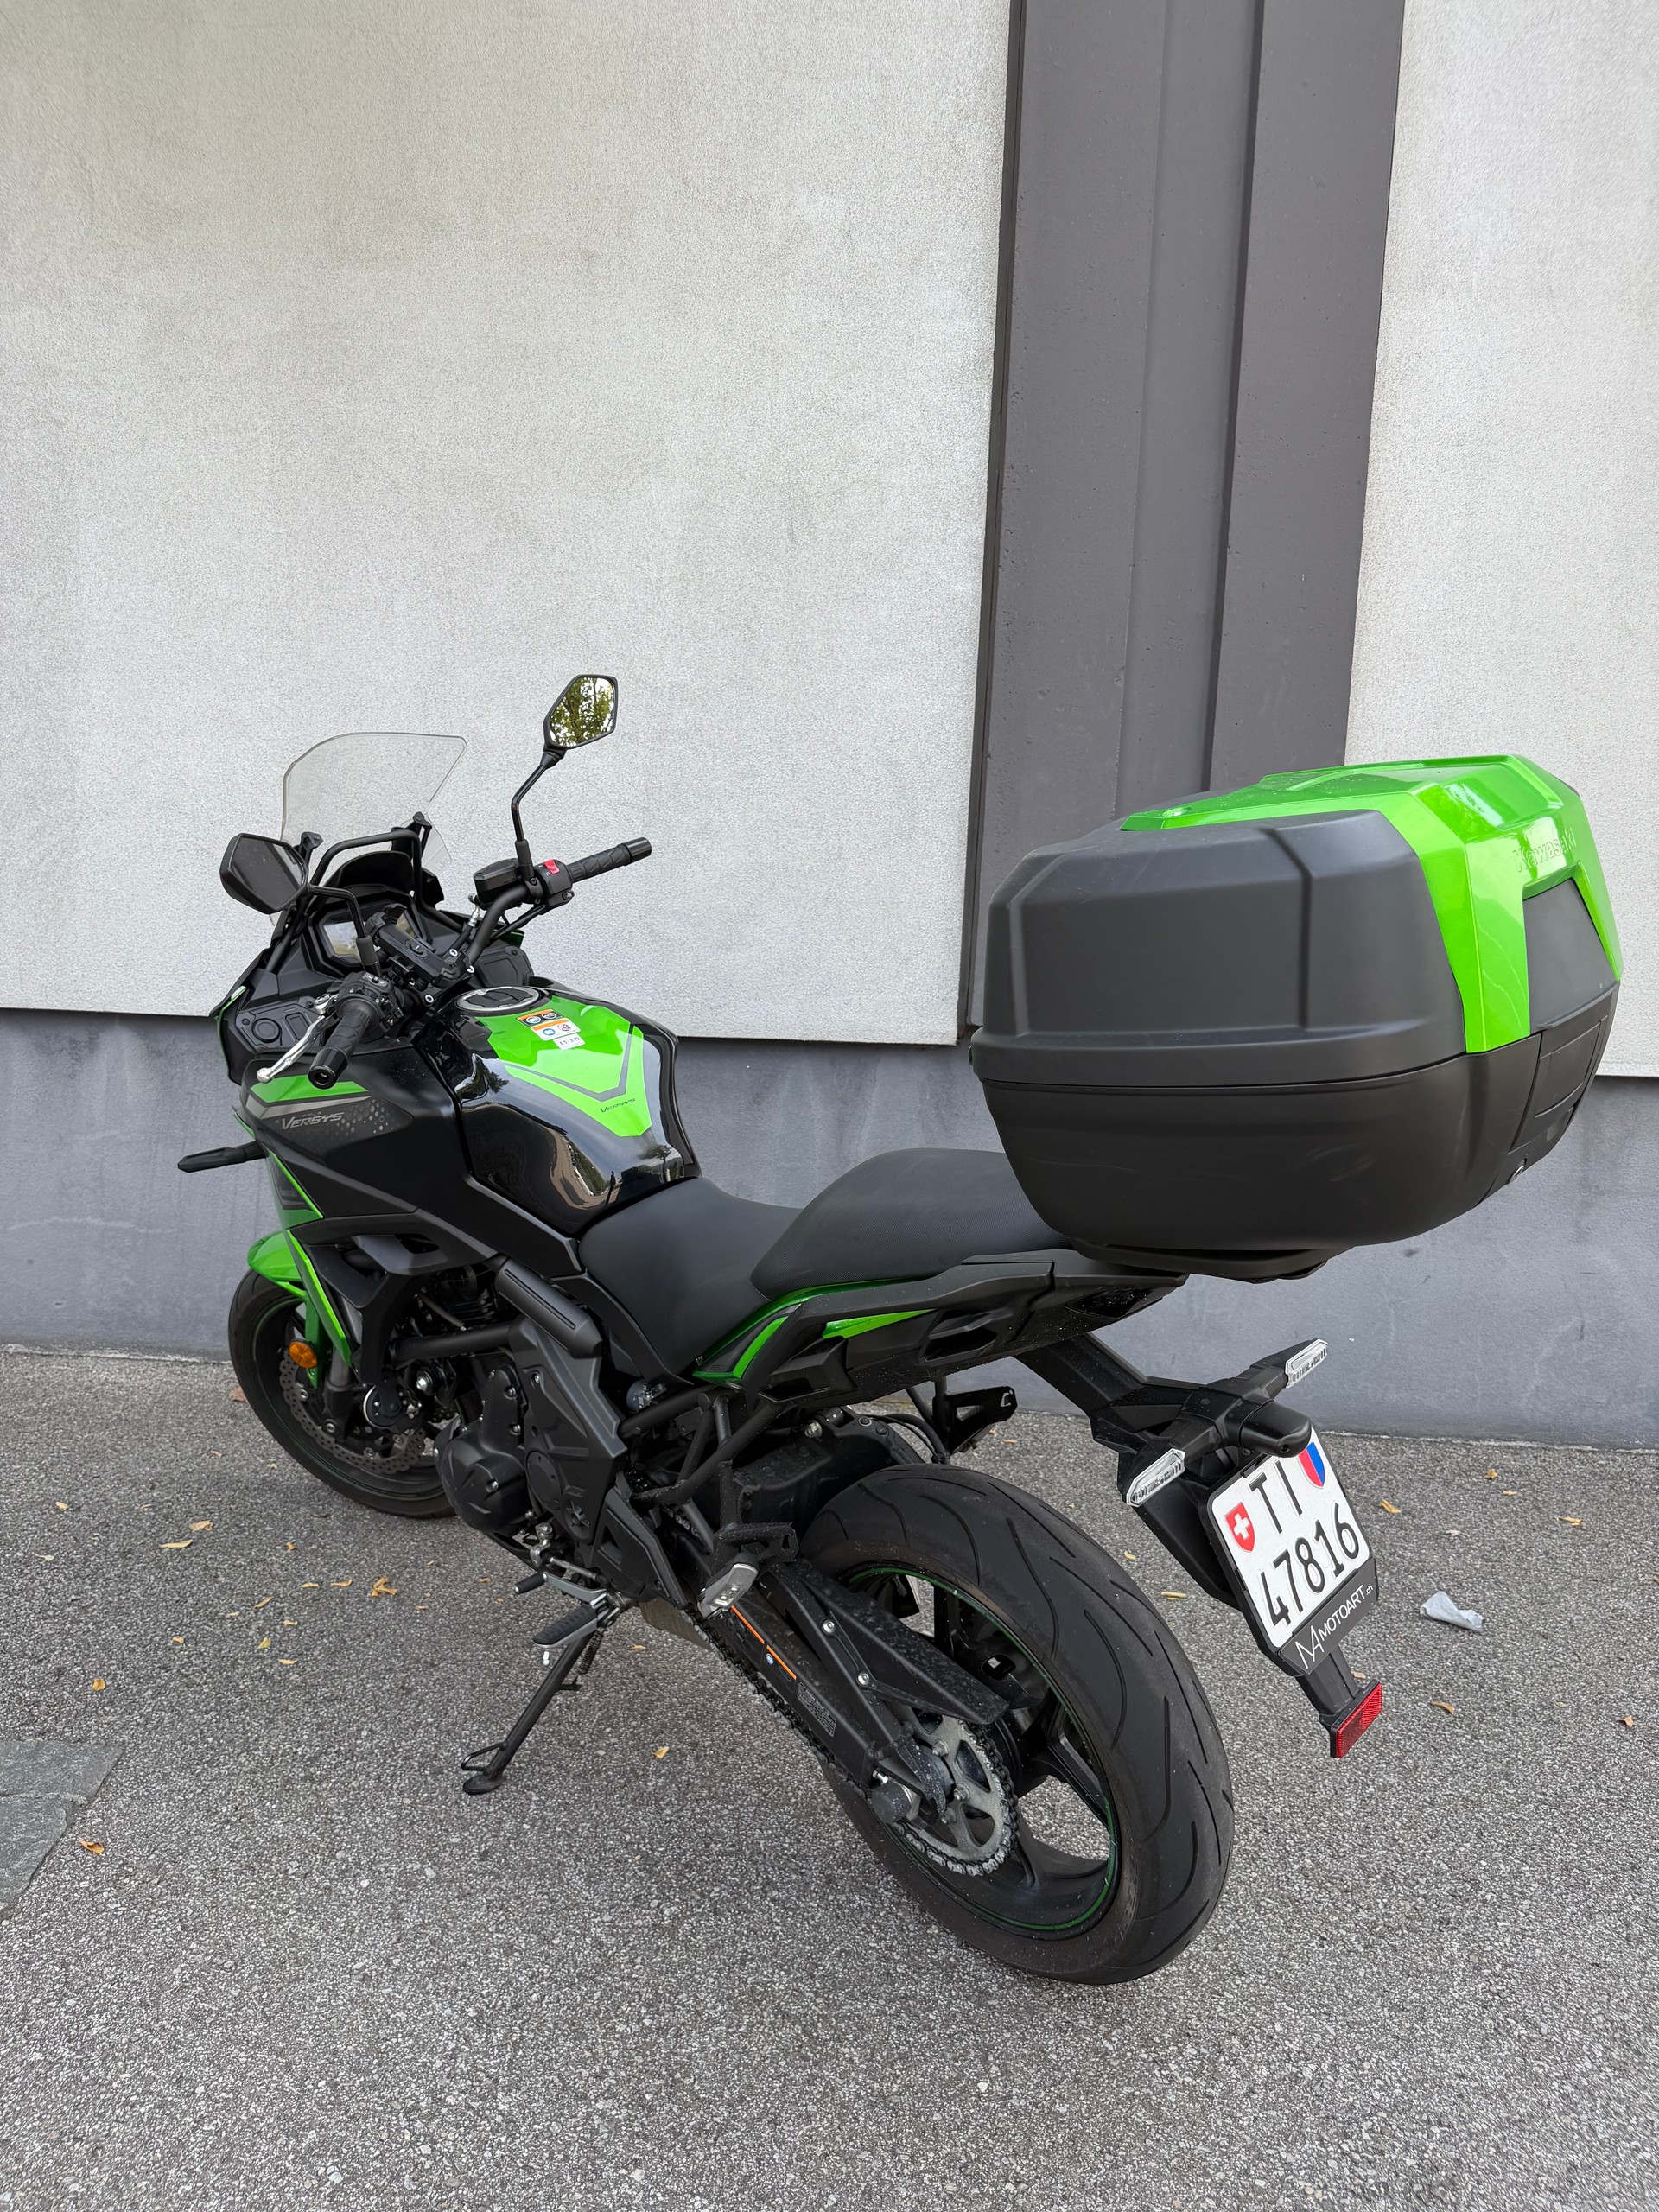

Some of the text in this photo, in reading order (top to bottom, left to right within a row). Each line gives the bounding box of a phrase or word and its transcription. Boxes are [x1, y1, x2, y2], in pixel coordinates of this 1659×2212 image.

[1512, 827, 1577, 873] Kawasaki
[282, 1112, 345, 1130] VERSYS
[1249, 1459, 1303, 1535] TI
[1260, 1502, 1360, 1627] 47816
